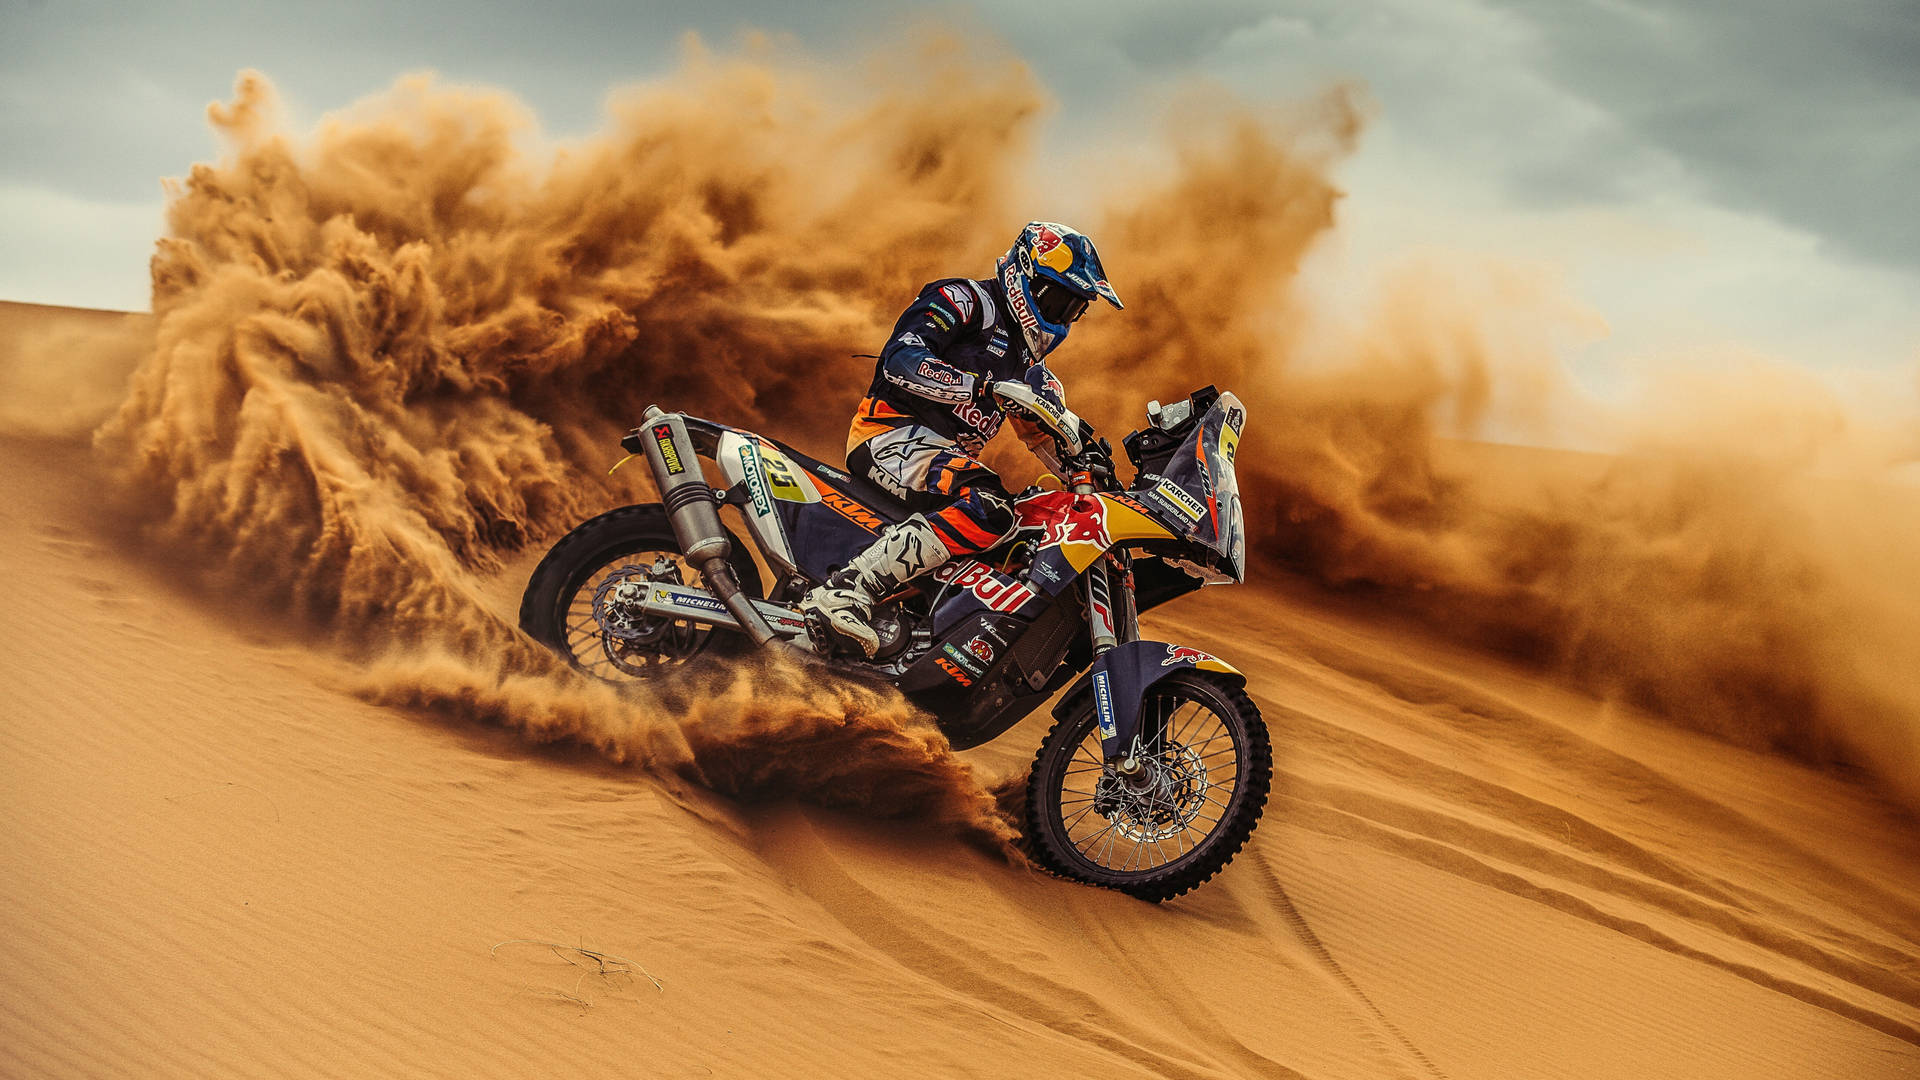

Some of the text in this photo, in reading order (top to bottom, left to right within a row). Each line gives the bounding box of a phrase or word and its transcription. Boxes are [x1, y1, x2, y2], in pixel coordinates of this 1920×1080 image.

[742, 454, 769, 519] MOTOREX
[1112, 494, 1150, 515] KTM
[821, 492, 884, 531] KTM
[1147, 490, 1189, 524] SAM SUNDERLAND
[952, 559, 1035, 615] Bull
[934, 656, 973, 688] KTM
[1098, 674, 1111, 724] MICHELIN
